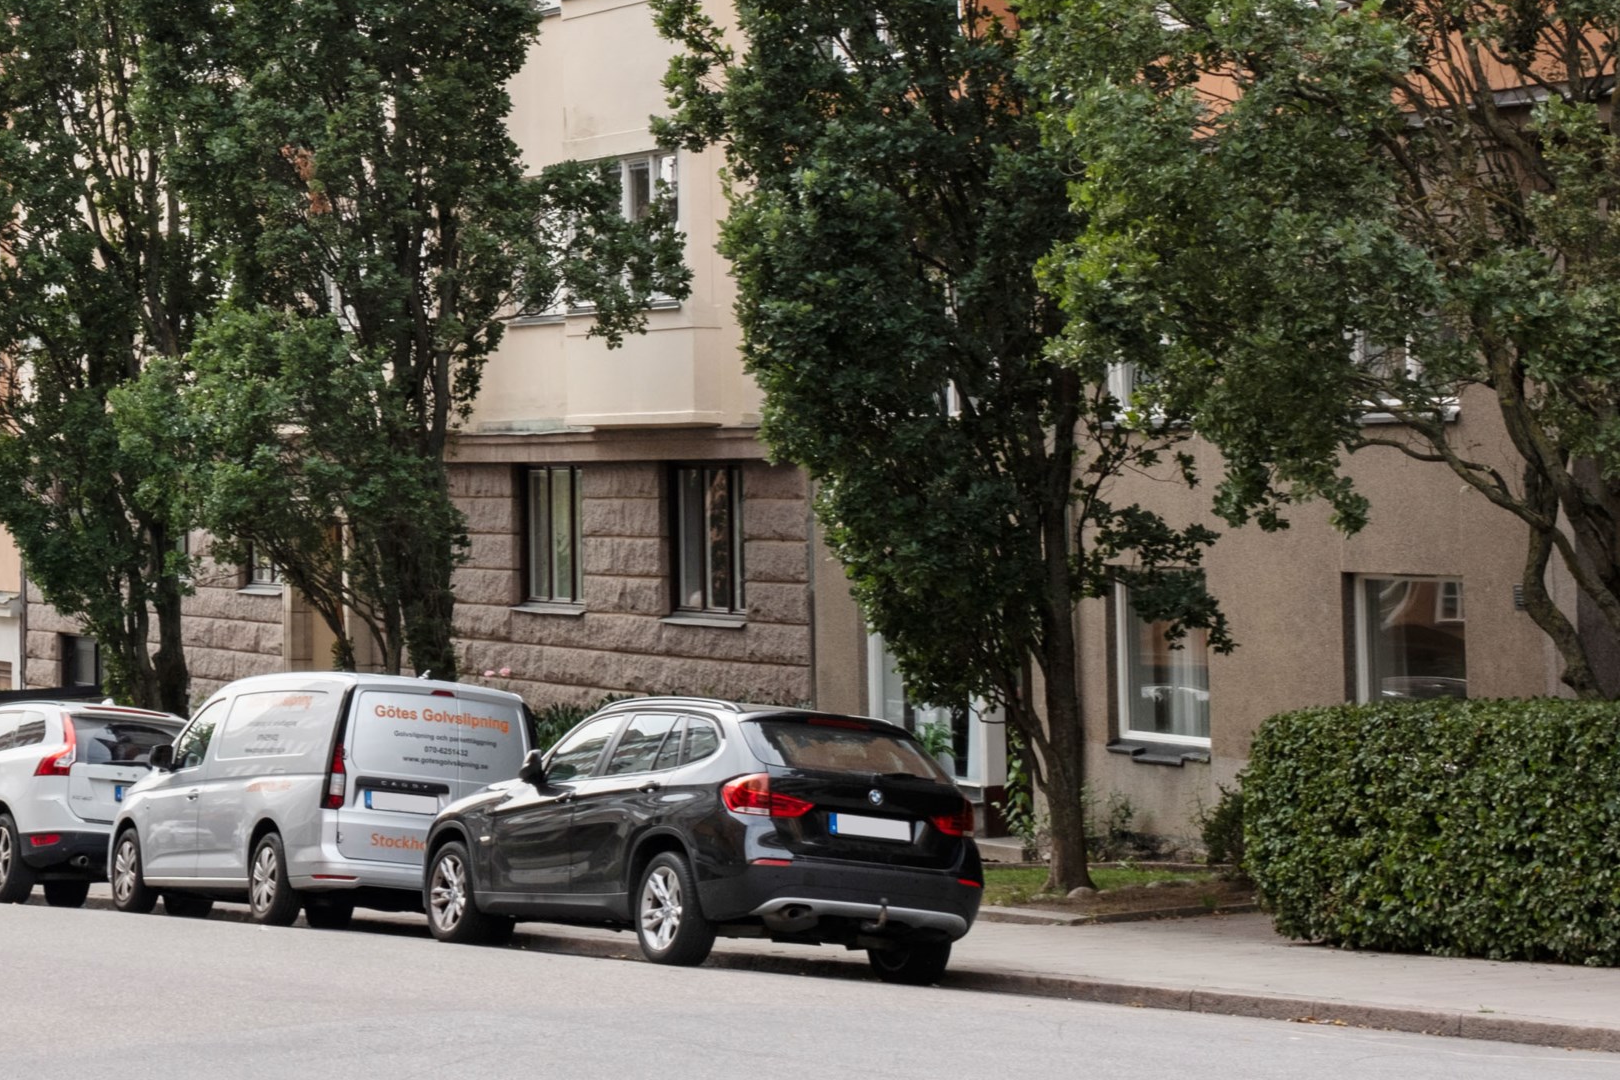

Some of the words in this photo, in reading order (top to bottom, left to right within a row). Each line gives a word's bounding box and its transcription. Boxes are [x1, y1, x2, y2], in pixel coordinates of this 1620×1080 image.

[374, 705, 418, 720] Götes
[422, 708, 509, 734] Golvslipning
[394, 730, 435, 742] Golvslipning
